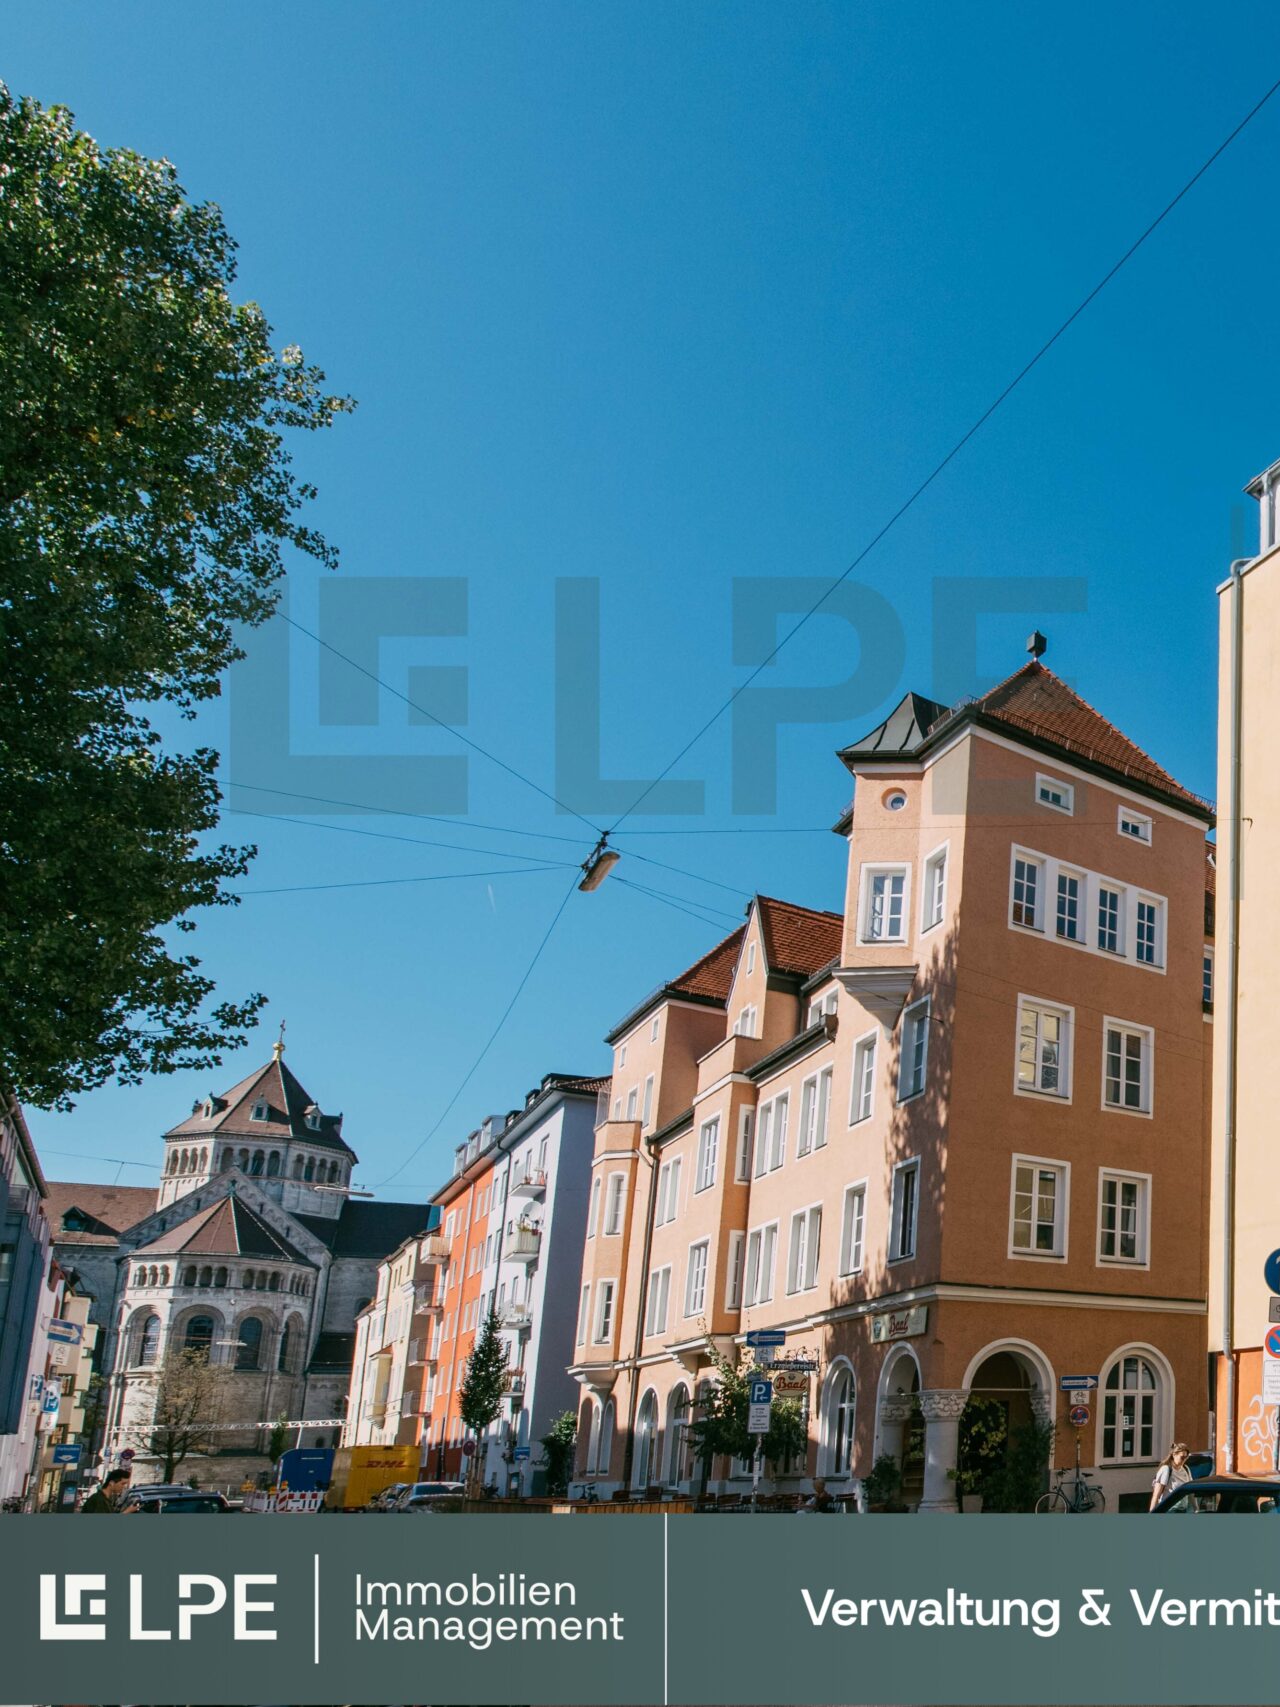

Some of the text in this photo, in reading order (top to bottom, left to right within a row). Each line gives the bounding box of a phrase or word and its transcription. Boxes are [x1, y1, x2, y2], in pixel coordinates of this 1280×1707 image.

[889, 1311, 909, 1337] Baal
[776, 1376, 807, 1391] Baal
[754, 1384, 766, 1401] P
